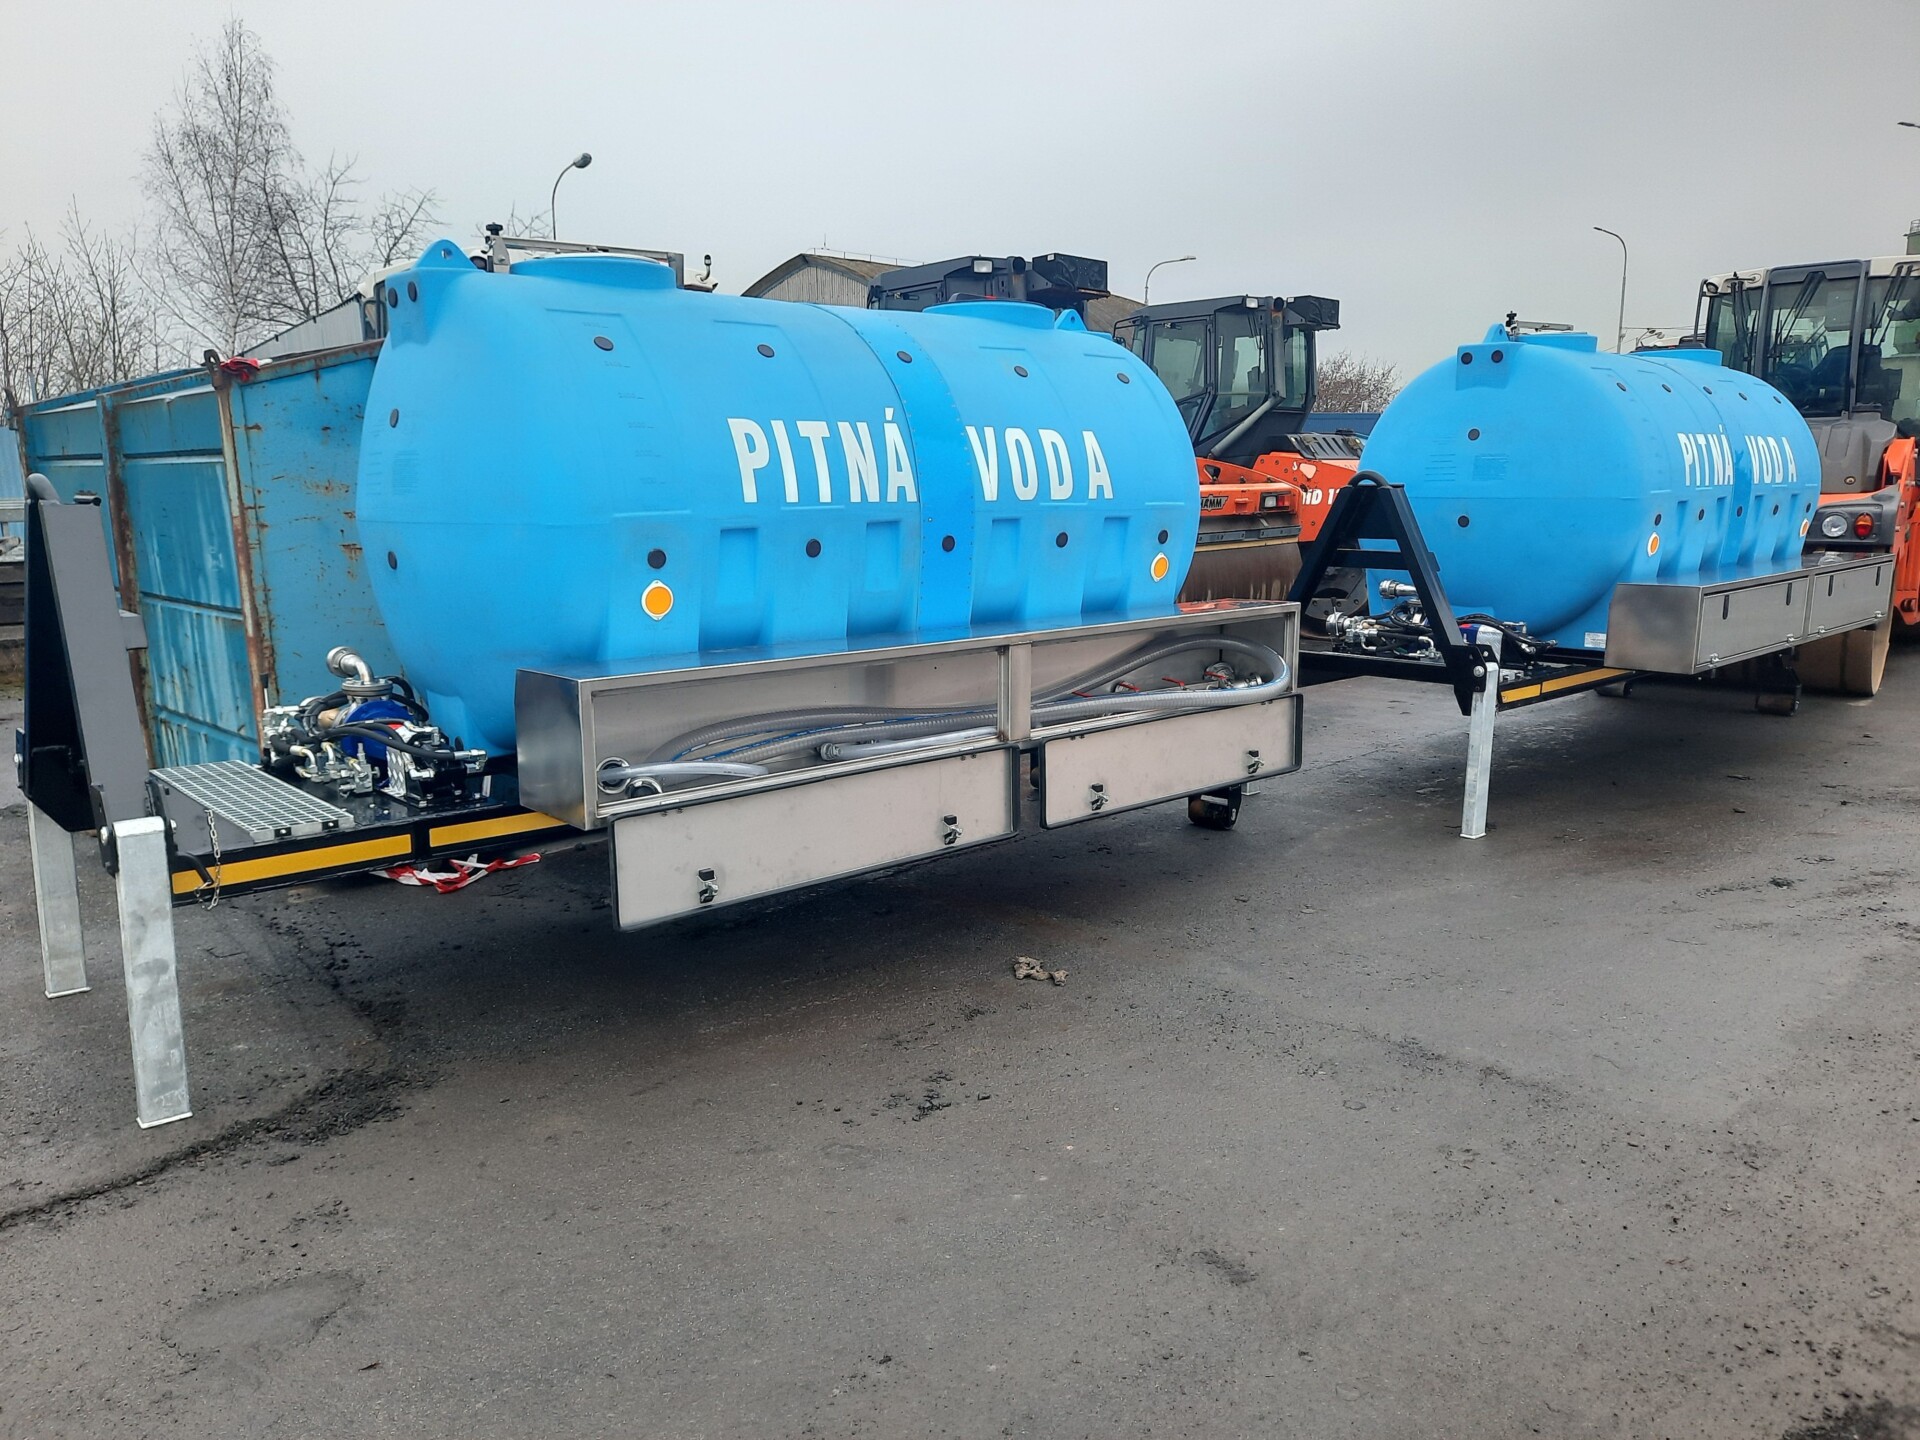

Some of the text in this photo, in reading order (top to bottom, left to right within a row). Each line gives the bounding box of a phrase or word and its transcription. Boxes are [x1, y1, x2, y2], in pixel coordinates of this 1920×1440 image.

[727, 407, 1114, 504] PITNÁ VODA
[1677, 424, 1797, 486] PITNÁ VODA
